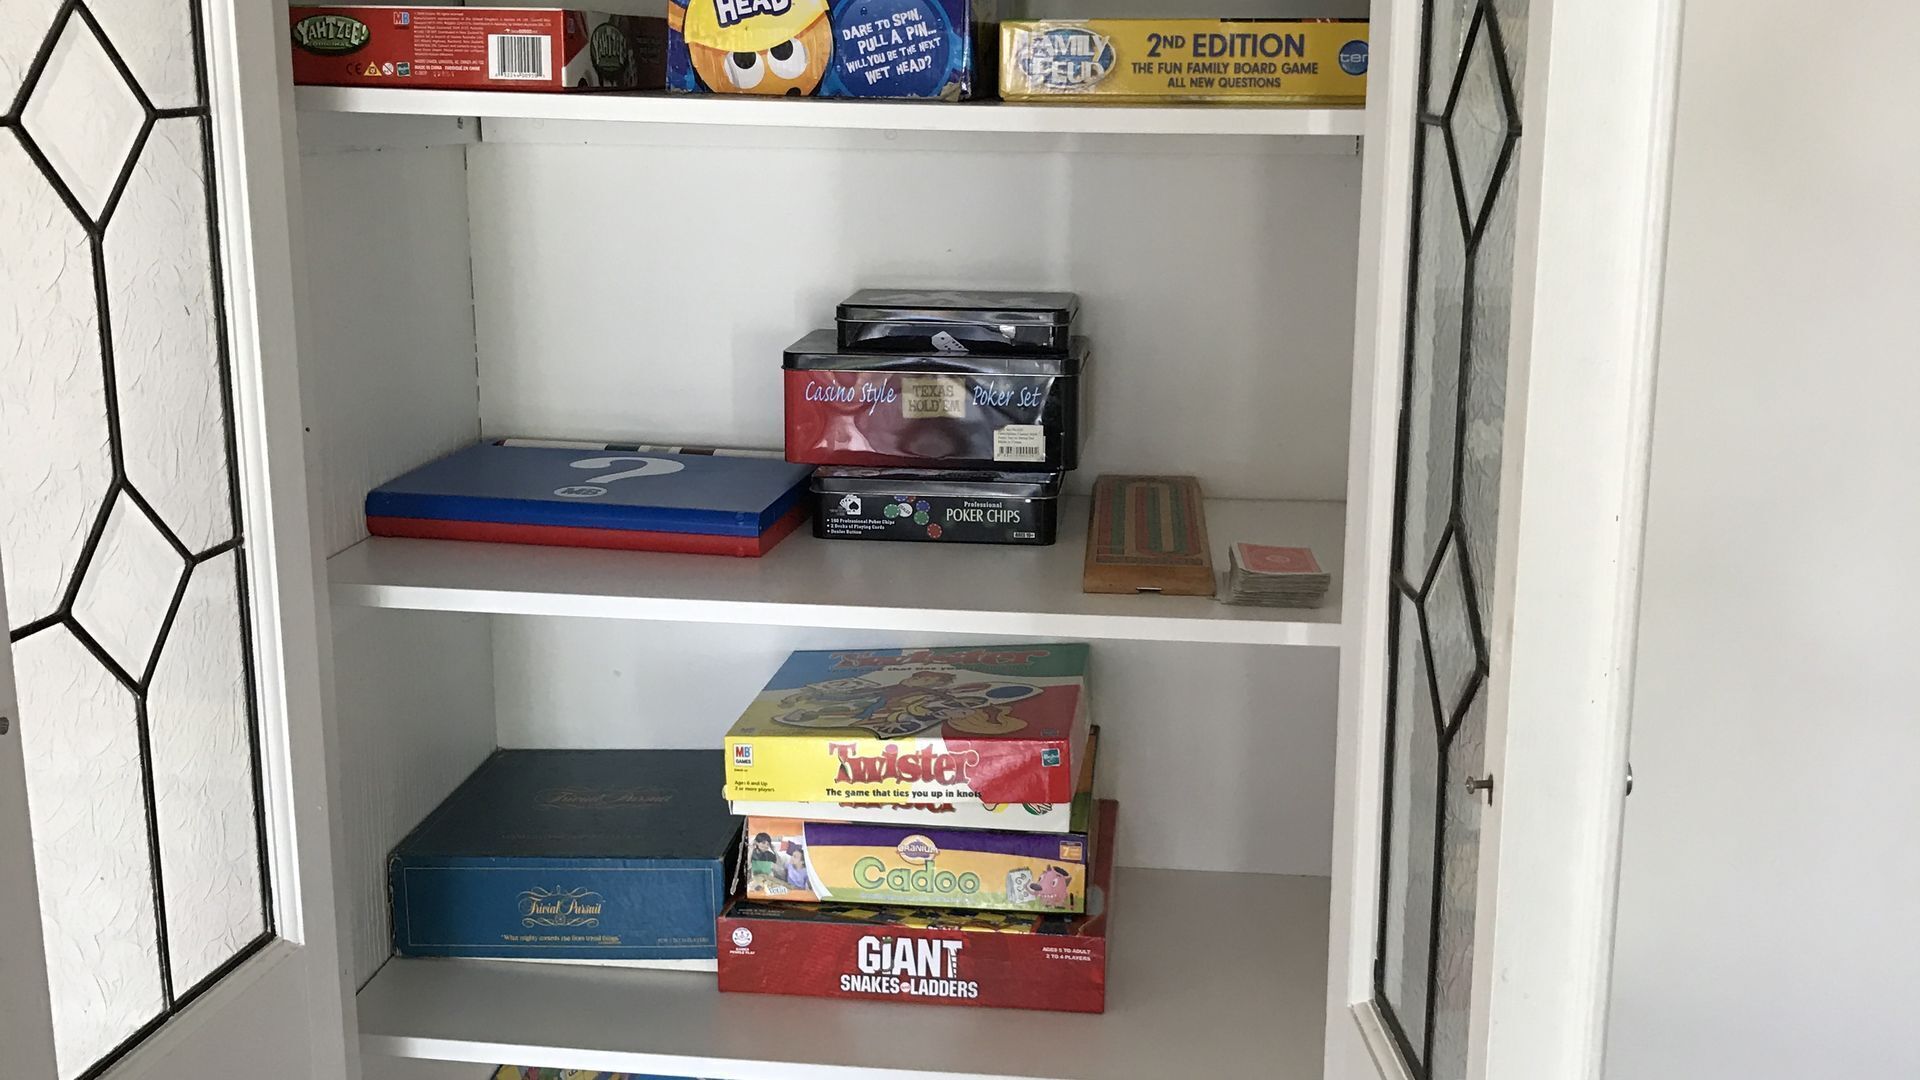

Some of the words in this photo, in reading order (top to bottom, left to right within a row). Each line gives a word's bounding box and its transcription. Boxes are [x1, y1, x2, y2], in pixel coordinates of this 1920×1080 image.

[296, 16, 368, 46] YAHTZEE!
[393, 11, 410, 26] MB
[842, 22, 873, 41] DARE
[875, 18, 891, 32] TO
[892, 8, 923, 27] SPIN,
[857, 34, 888, 55] PULL
[891, 29, 903, 45] A
[905, 21, 937, 41] PIN...
[1147, 32, 1186, 58] 2ND
[1192, 33, 1305, 58] EDITION
[846, 58, 868, 74] WILL
[867, 52, 886, 67] YOU
[887, 50, 898, 61] BE
[898, 44, 917, 57] THE
[918, 37, 942, 52] NEXT
[864, 66, 890, 85] WET
[895, 55, 932, 76] HEAD?
[1131, 62, 1153, 74] THE
[1157, 62, 1183, 74] FUN
[1186, 62, 1228, 74] FAMILY
[1233, 62, 1277, 75] BOARD
[1281, 62, 1319, 75] GAME
[1167, 77, 1186, 88] ALL
[1190, 77, 1214, 88] NEW
[1218, 77, 1281, 89] QUESTIONS
[805, 379, 856, 401] Casino
[858, 378, 898, 416] Style
[912, 384, 954, 398] TEXAS
[972, 380, 1015, 407] Poker
[1016, 386, 1042, 407] Set
[946, 508, 984, 523] POKER
[986, 509, 1021, 524] CHIPS
[963, 500, 1003, 509] Professional
[735, 746, 751, 758] MB
[829, 743, 979, 786] Twister
[825, 788, 842, 797] The
[845, 790, 870, 798] game
[872, 789, 891, 797] that
[893, 789, 909, 797] ties
[912, 791, 930, 799] you
[931, 791, 943, 799] up
[946, 790, 954, 798] in
[956, 789, 982, 799] knots
[853, 856, 981, 895] Cadoo
[524, 896, 561, 915] Trivial
[562, 898, 602, 916] Pursuit
[840, 974, 900, 995] SNAKES
[910, 978, 979, 999] LADDERS
